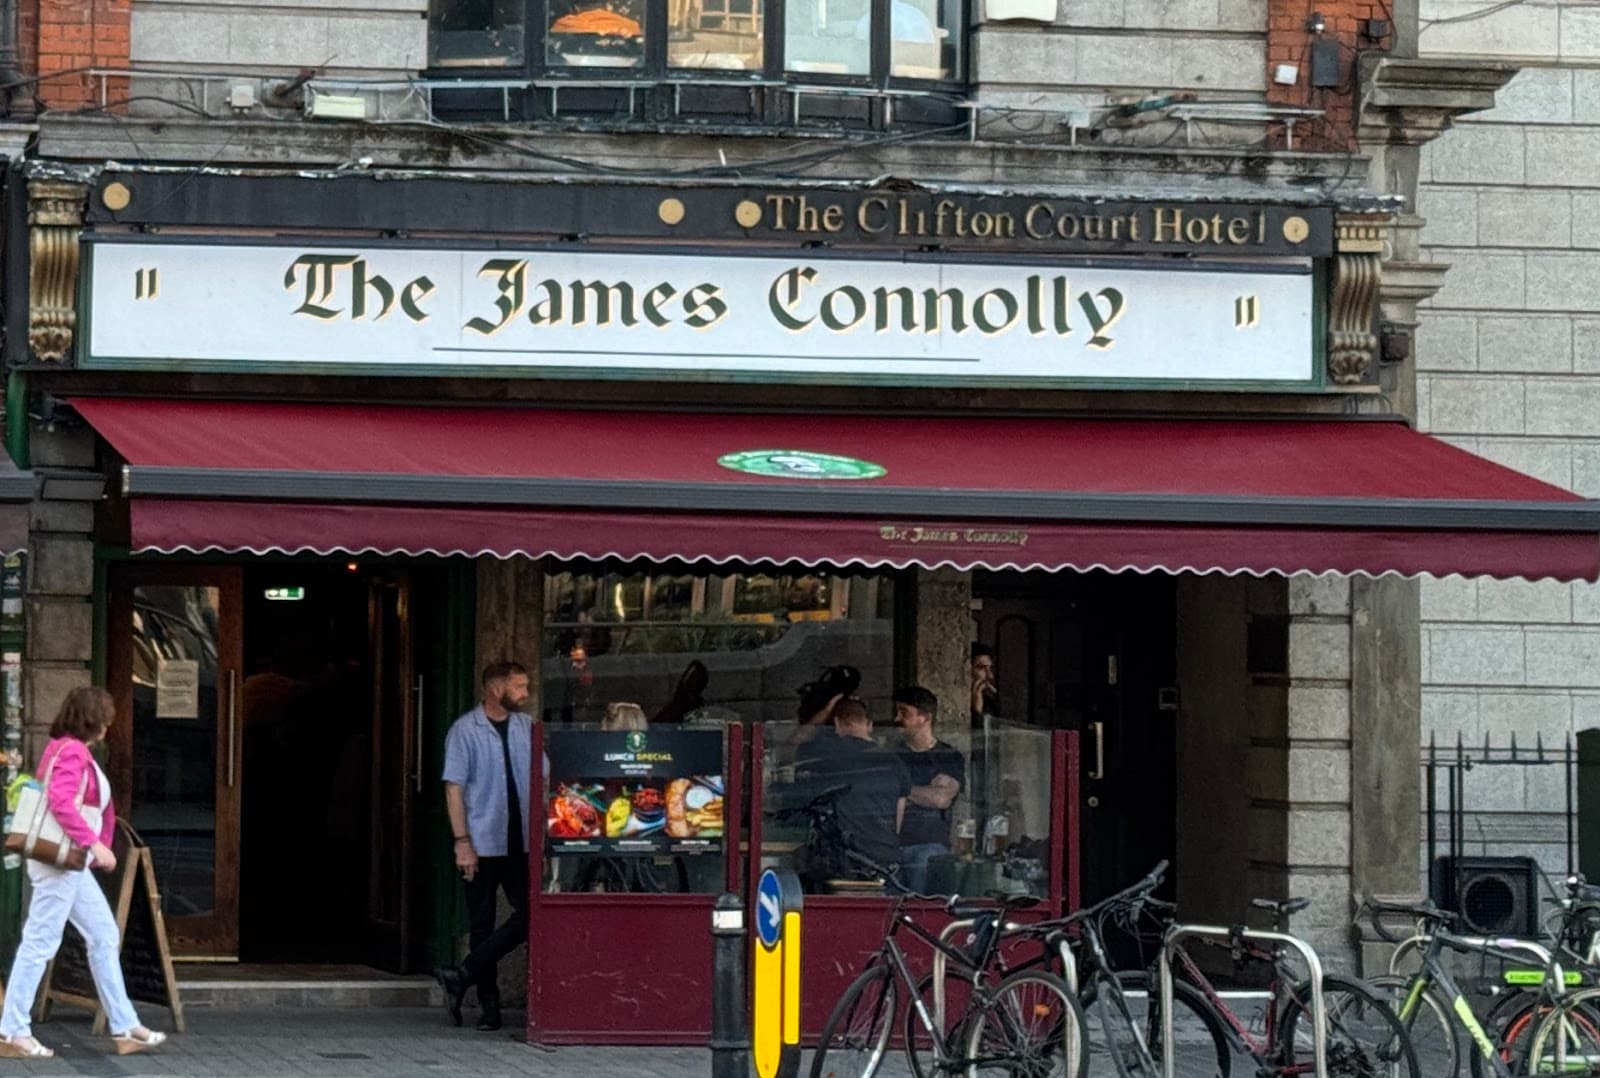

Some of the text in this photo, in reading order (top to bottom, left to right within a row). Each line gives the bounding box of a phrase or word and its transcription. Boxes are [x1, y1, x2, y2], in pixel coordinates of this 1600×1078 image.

[765, 194, 1266, 245] The Clifton Court Hotel
[283, 253, 1126, 349] The James Connolly
[880, 526, 1029, 547] The James Connolly
